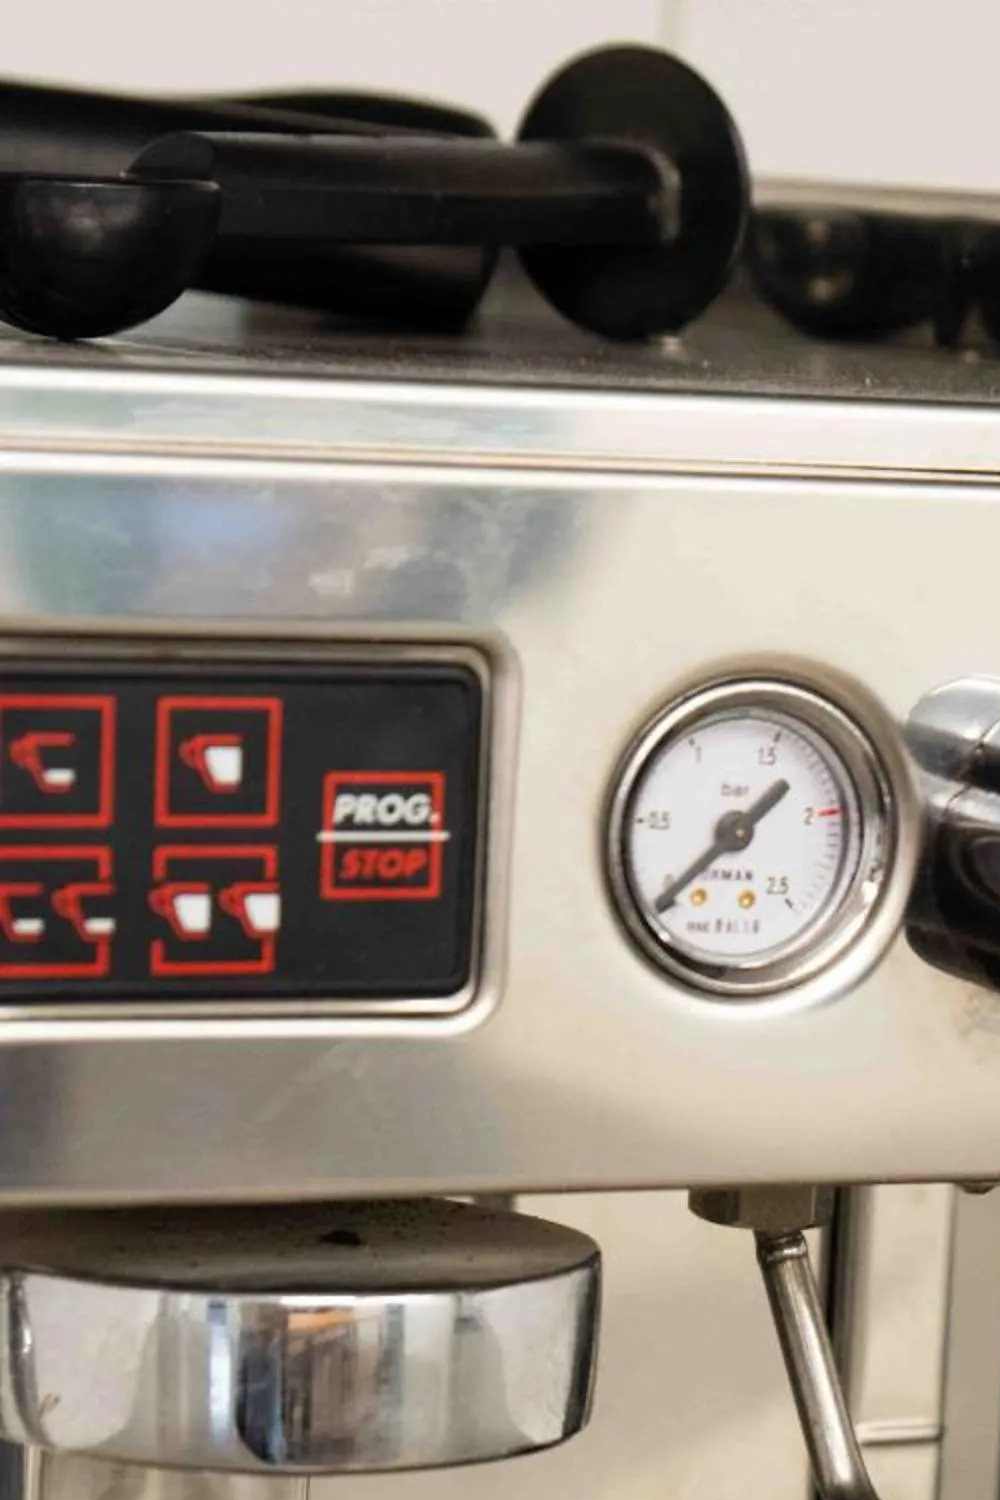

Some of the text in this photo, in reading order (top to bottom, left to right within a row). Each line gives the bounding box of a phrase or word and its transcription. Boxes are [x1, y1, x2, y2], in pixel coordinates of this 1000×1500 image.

[720, 780, 751, 797] bar
[332, 792, 441, 826] PROG.
[803, 806, 815, 826] 2
[339, 848, 427, 880] STOP
